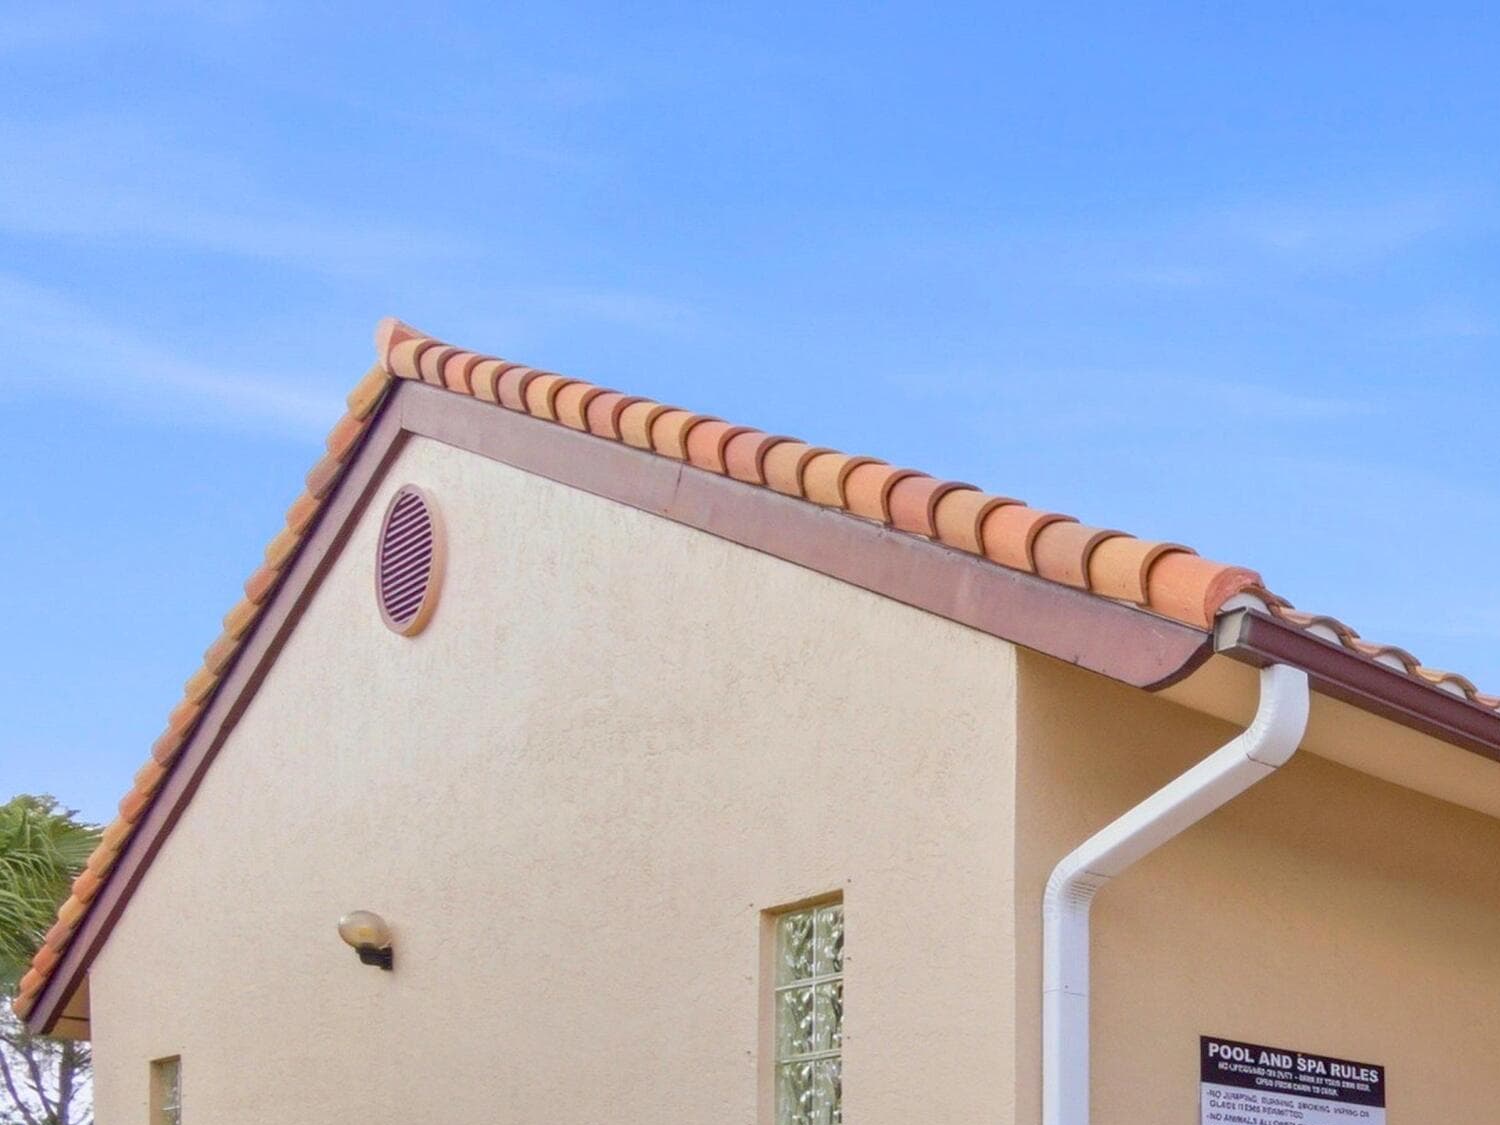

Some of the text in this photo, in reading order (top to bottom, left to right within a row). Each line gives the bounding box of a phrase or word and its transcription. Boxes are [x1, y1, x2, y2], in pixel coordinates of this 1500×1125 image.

[1208, 1042, 1254, 1064] POOL
[1258, 1050, 1292, 1070] AND
[1297, 1056, 1327, 1075] SPA
[1330, 1062, 1379, 1083] RULES
